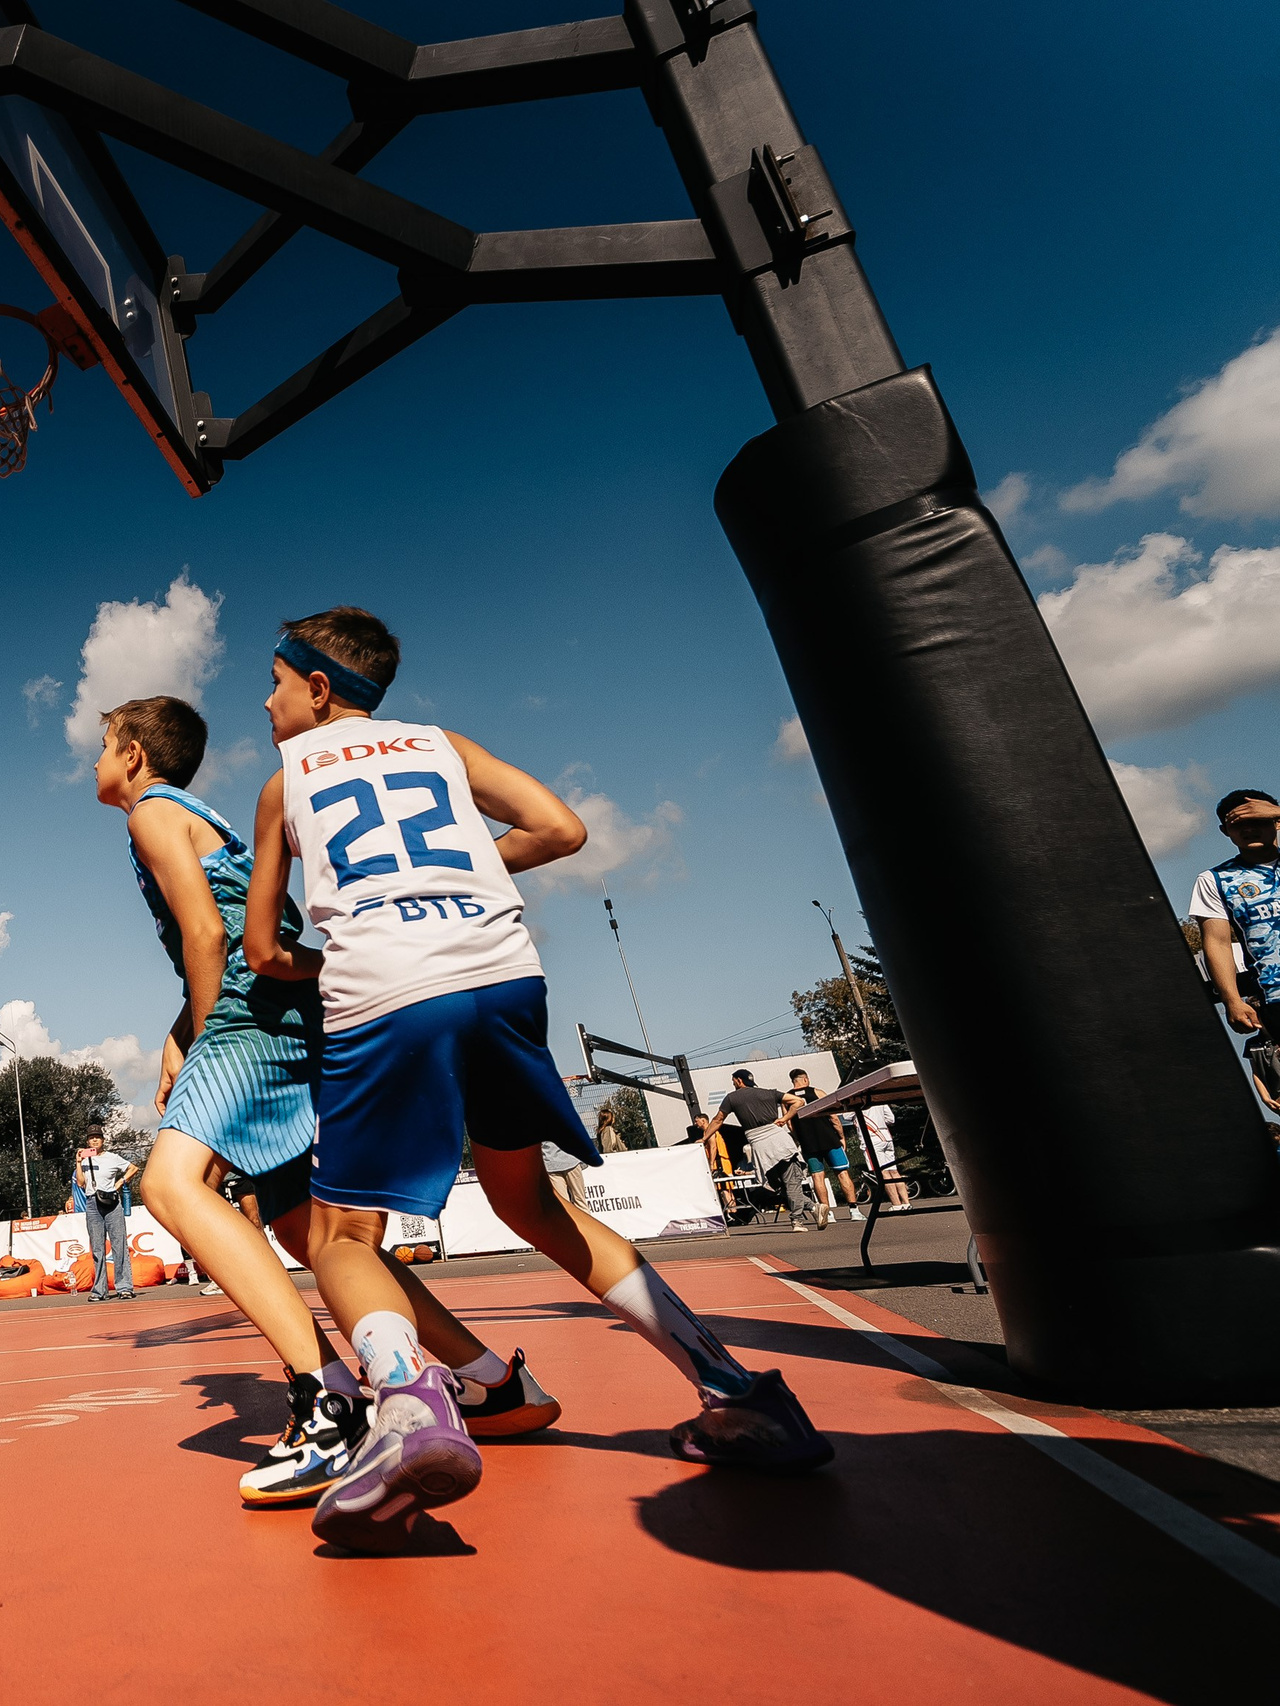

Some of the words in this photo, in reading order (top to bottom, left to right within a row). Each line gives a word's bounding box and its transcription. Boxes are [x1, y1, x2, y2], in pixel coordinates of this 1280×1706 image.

[341, 737, 436, 762] DKC
[309, 771, 474, 891] 22
[392, 894, 487, 923] ВТБ
